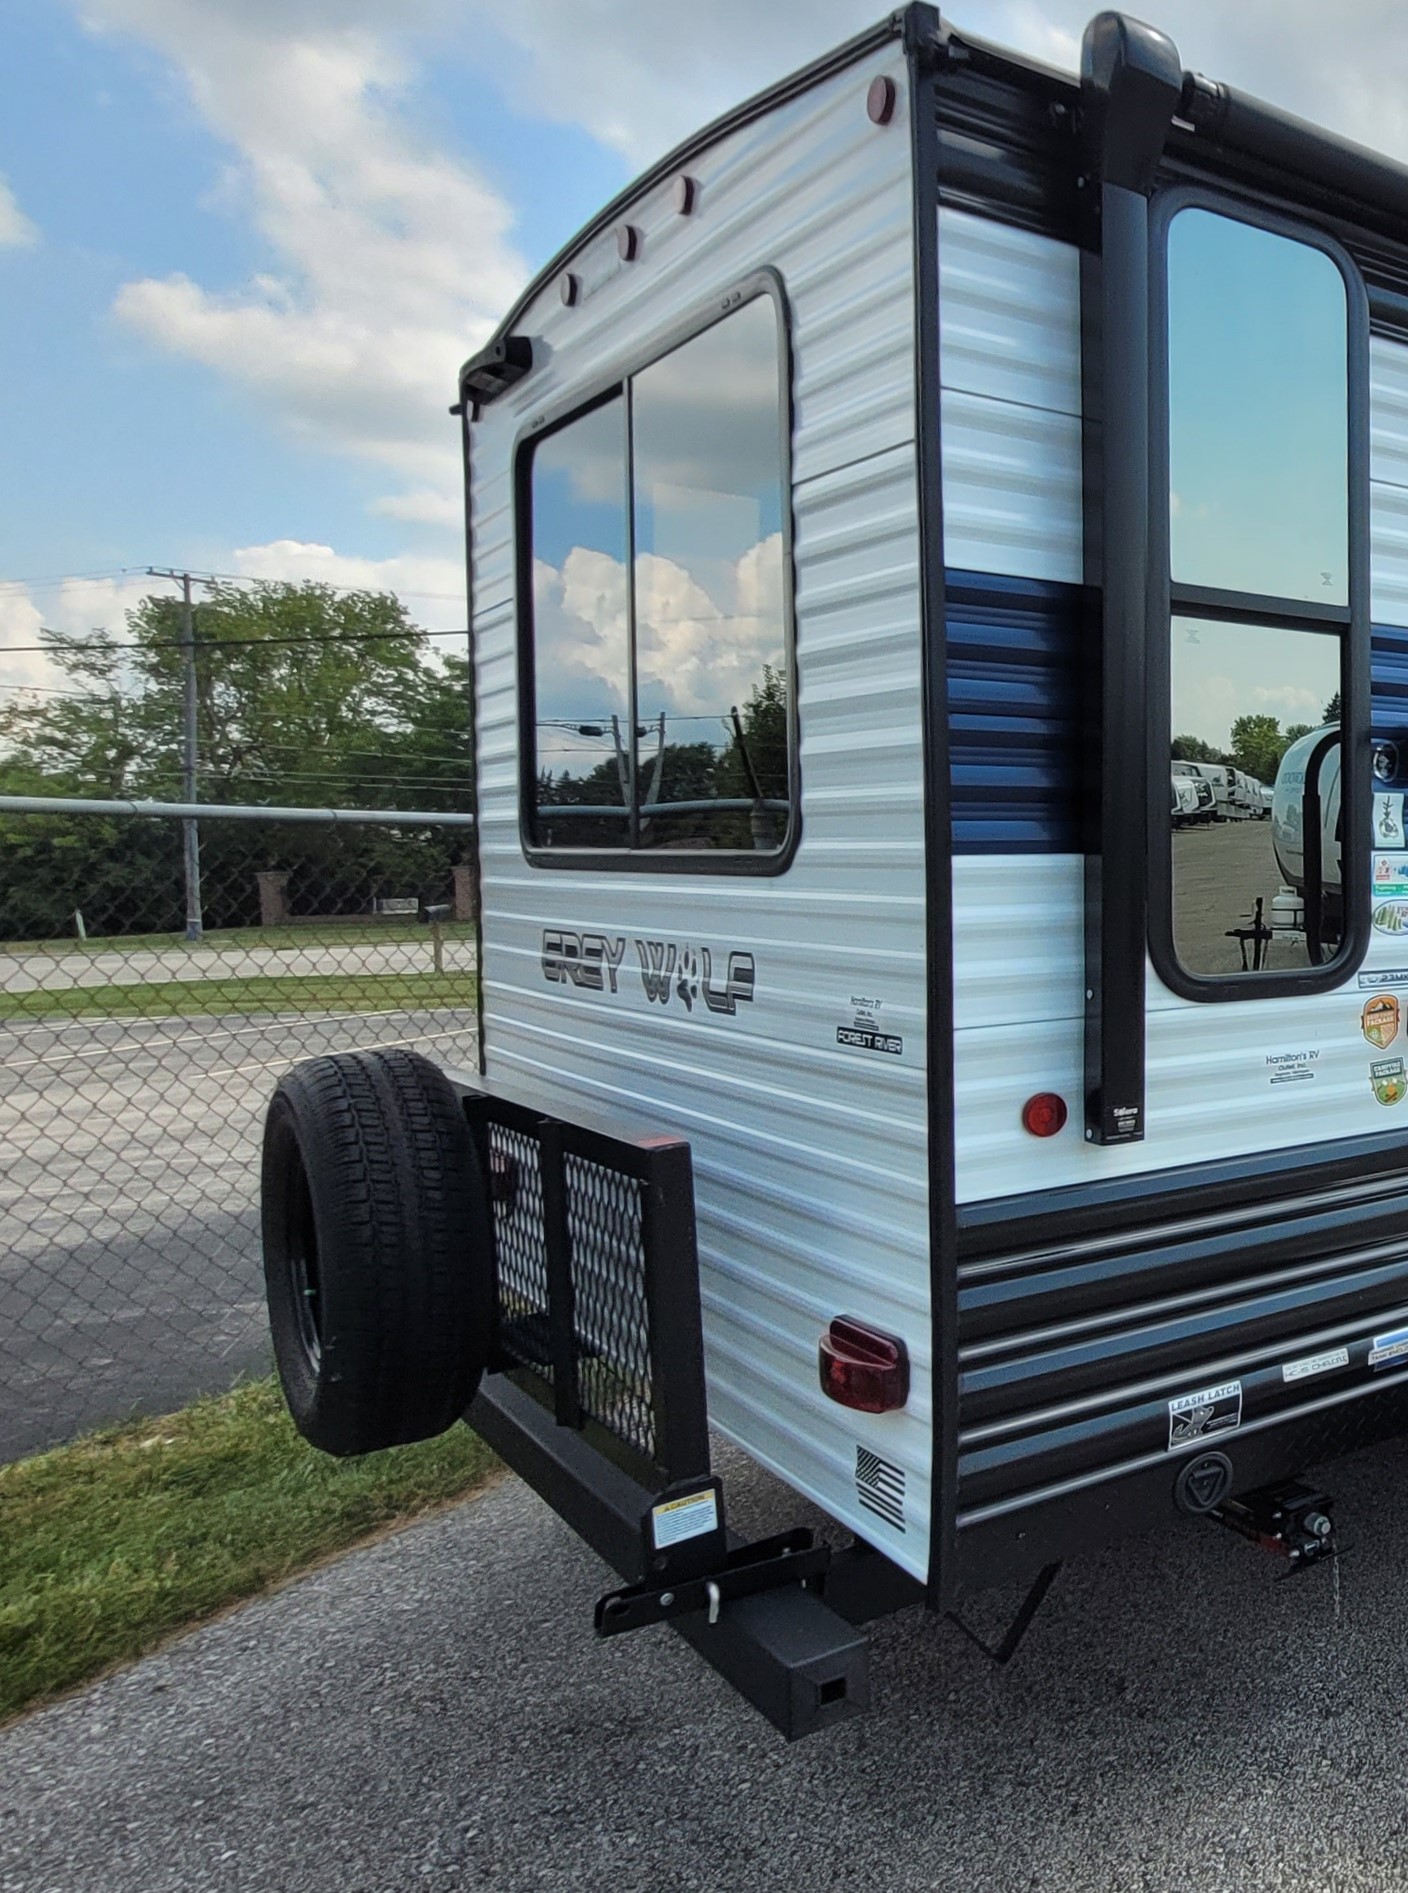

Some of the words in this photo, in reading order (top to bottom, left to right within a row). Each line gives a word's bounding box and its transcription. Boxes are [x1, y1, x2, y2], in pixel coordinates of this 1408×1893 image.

[540, 928, 626, 994] GREY
[838, 1029, 873, 1047] FOREST
[874, 1036, 902, 1053] RIVER
[1265, 1052, 1307, 1065] Hamilton's
[1309, 1049, 1320, 1060] RV
[1171, 1394, 1205, 1412] LEASH
[1208, 1383, 1240, 1400] LATCH
